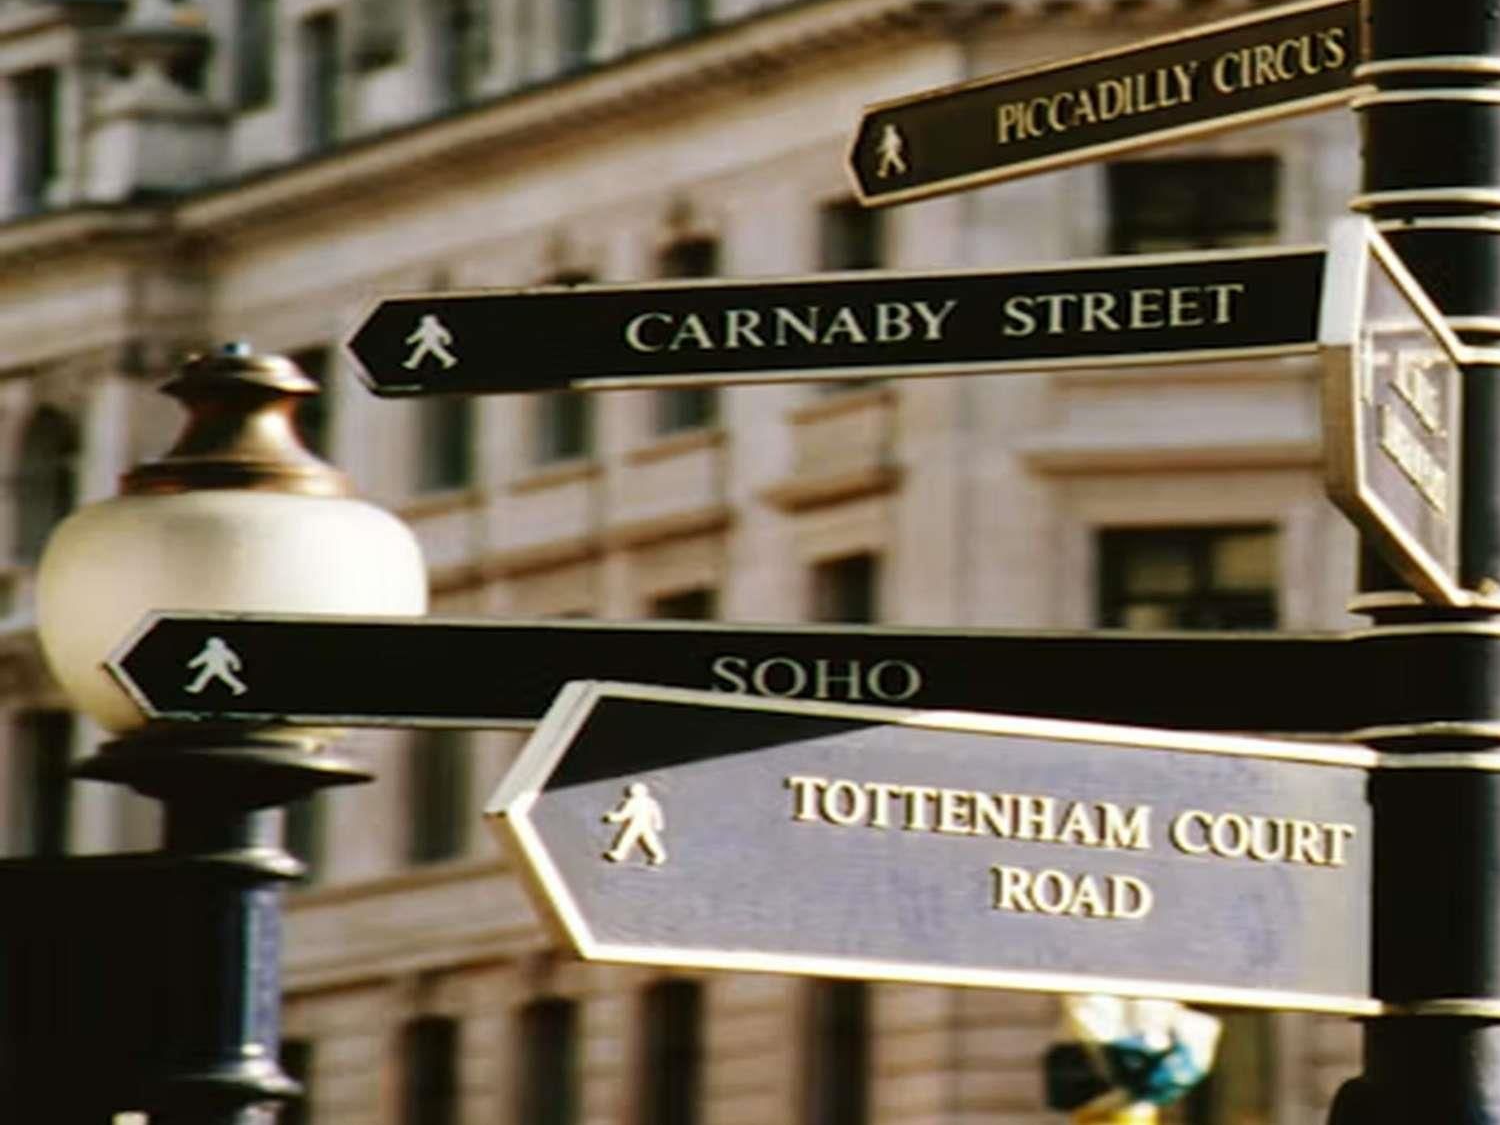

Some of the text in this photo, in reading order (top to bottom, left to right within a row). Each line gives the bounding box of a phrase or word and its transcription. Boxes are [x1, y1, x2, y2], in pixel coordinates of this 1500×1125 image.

[998, 27, 1347, 144] PICCADILLY CIRCUS
[625, 283, 1245, 352] CARNABY STREET
[710, 655, 923, 701] SOHO
[787, 775, 1356, 867] TOTTENHAM COURT
[992, 865, 1154, 920] ROAD
